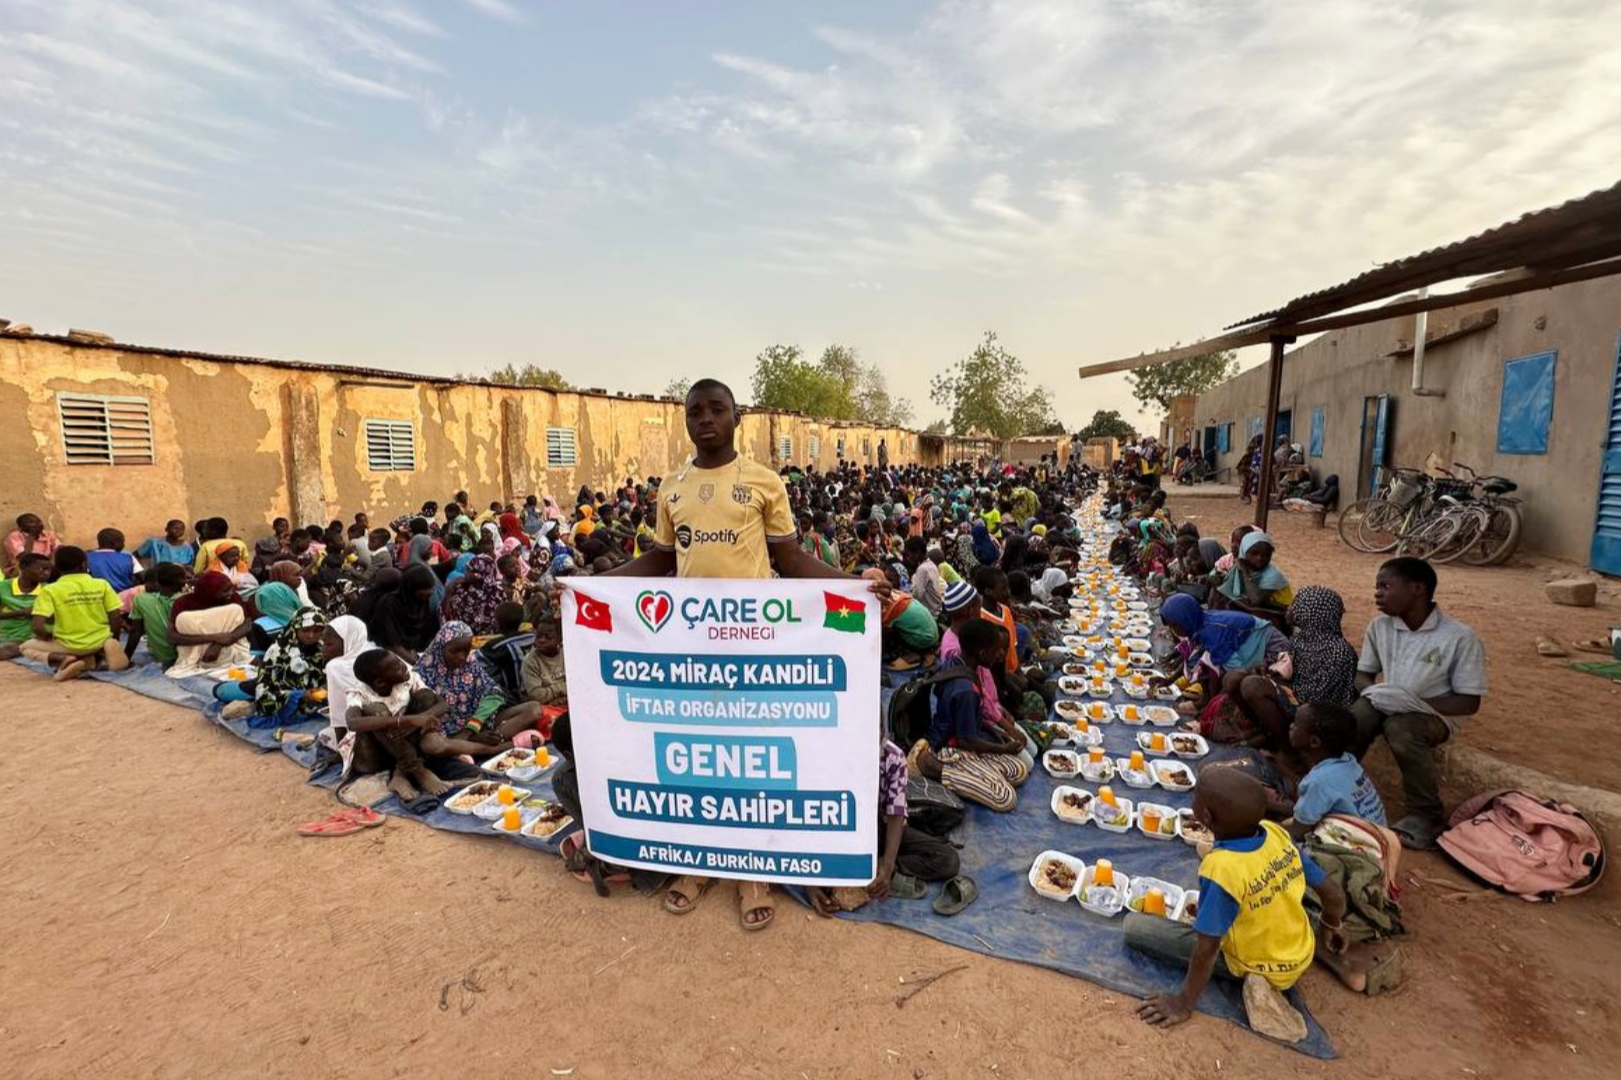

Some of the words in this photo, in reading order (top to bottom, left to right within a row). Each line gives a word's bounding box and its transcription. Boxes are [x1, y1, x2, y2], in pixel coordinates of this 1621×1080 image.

[694, 529, 740, 544] Spotify
[681, 597, 757, 629] ÇARE
[762, 598, 802, 623] OL
[612, 659, 665, 682] 2024
[670, 657, 738, 689] MİRAÇ
[743, 658, 834, 684] KANDİLİ
[626, 692, 676, 716] İFTAR
[680, 697, 831, 719] ORGANİZASYONU
[665, 741, 792, 779] GENEL
[614, 787, 694, 818] HAYIR
[700, 791, 848, 826] SAHİPLERİ
[638, 844, 702, 865] AFRİKA/
[706, 852, 776, 872] BURKİNA
[780, 858, 822, 874] FASO
